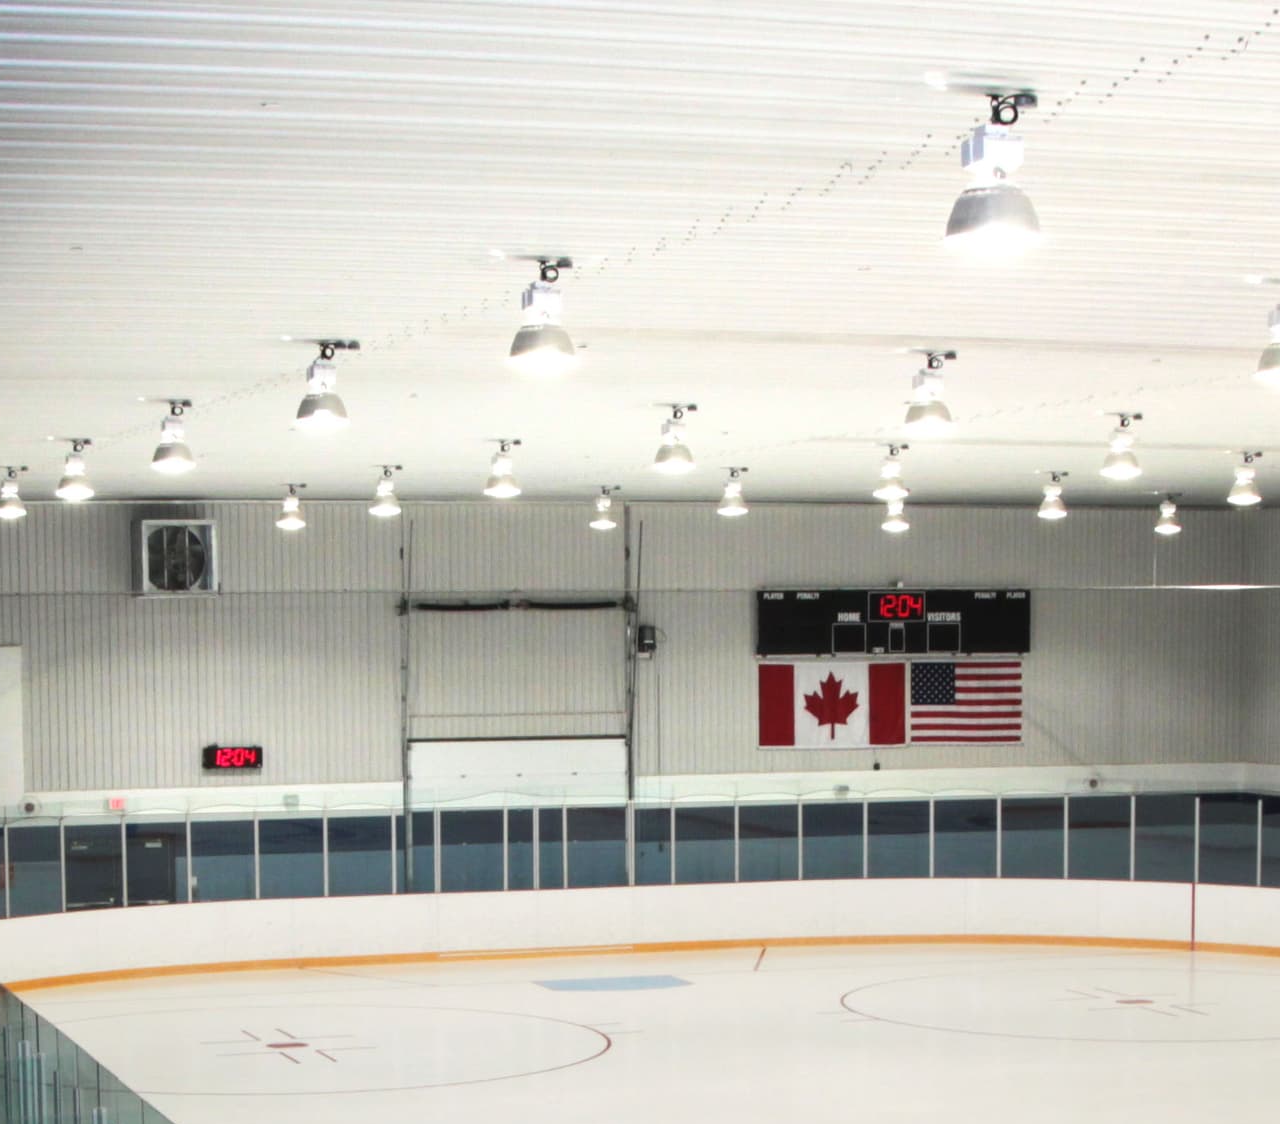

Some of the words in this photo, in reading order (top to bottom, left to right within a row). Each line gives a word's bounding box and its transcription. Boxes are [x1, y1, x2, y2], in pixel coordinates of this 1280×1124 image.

[880, 594, 922, 618] 12:04
[837, 612, 861, 622] HOME
[927, 612, 962, 622] VISITORS
[216, 748, 257, 767] 12:04
